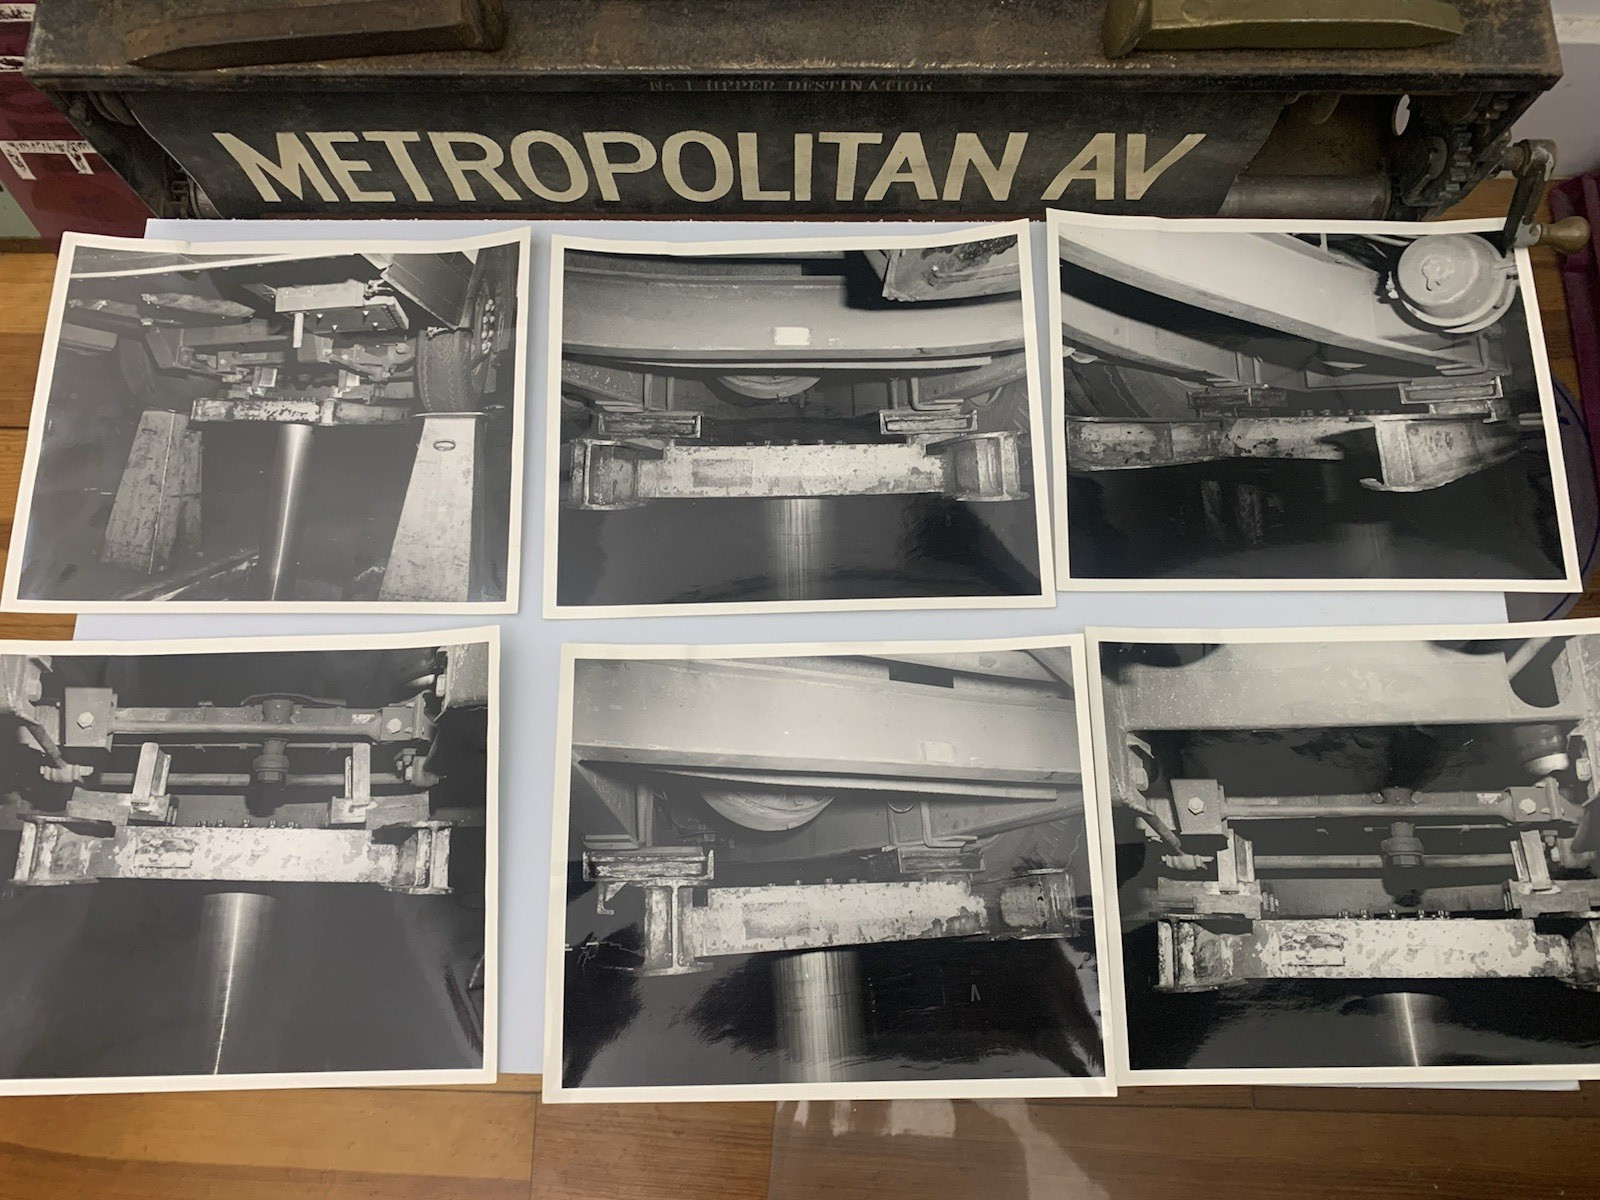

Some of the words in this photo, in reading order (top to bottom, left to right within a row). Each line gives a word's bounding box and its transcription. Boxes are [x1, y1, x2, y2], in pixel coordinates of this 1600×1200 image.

[706, 79, 775, 92] UPPER
[212, 130, 1029, 203] METROPOLITAN
[1041, 131, 1207, 202] AV
